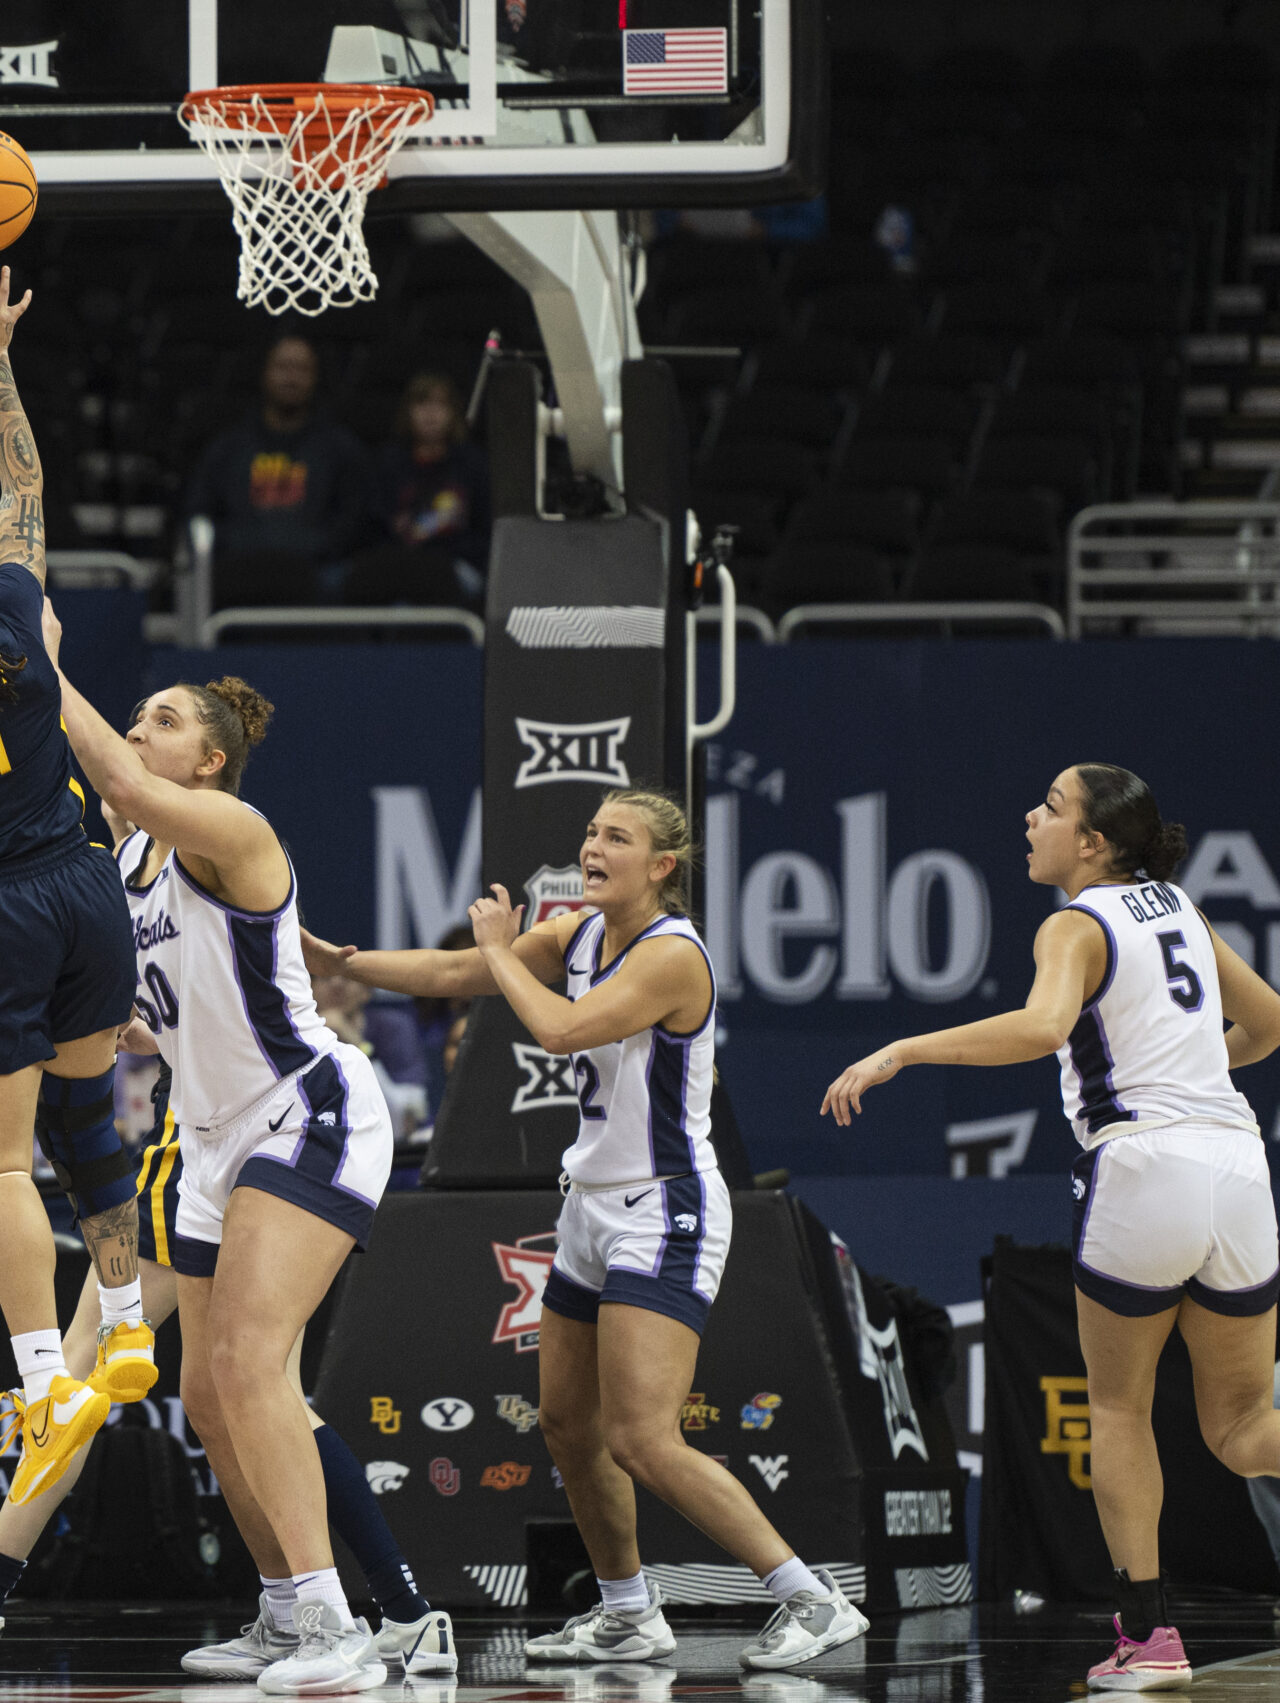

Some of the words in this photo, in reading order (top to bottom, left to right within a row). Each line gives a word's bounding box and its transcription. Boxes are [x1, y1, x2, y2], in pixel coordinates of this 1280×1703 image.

[371, 785, 992, 1005] Melo
[540, 880, 584, 897] PHILL
[1120, 881, 1182, 924] GLENN
[1154, 928, 1205, 1014] 5
[431, 1402, 465, 1428] Y
